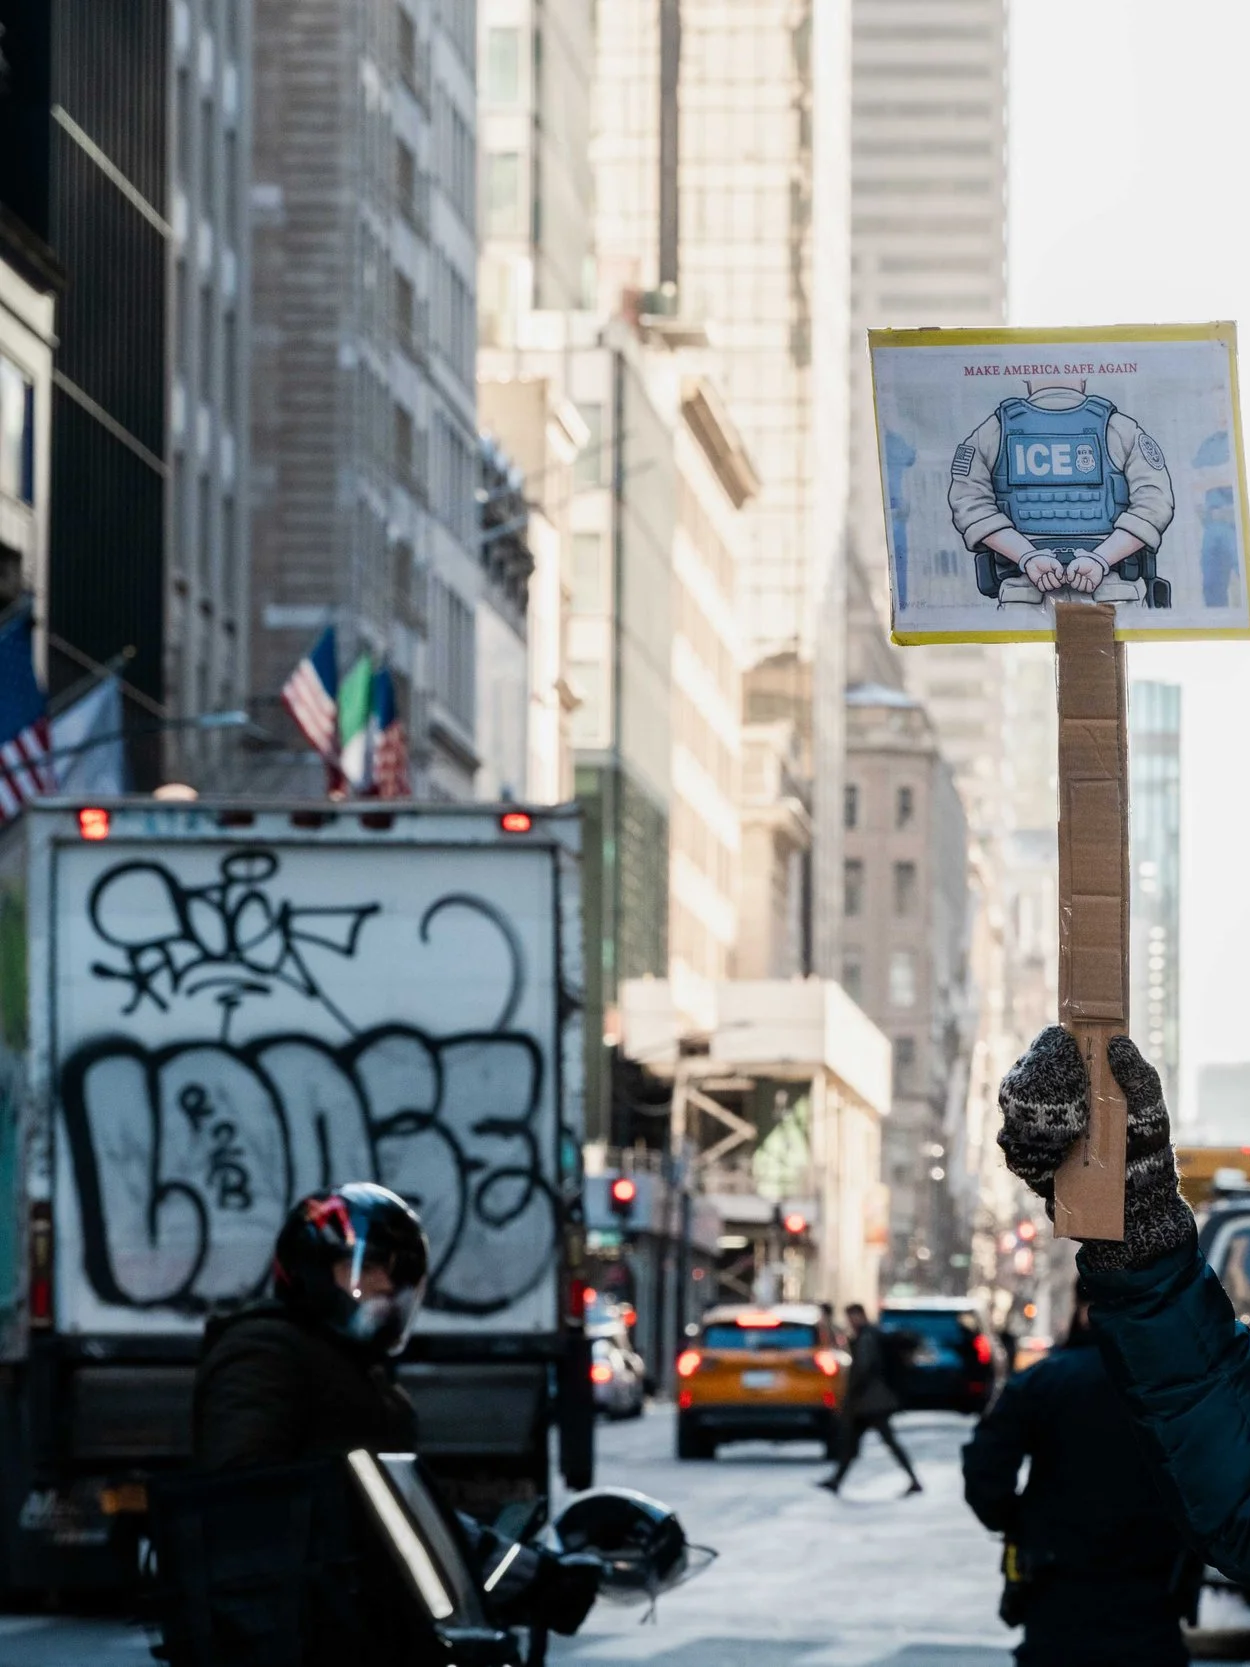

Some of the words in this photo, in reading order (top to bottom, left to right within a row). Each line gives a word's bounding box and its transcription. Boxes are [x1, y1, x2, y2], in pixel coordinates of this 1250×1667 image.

[964, 365, 1001, 377] MAKE
[1003, 364, 1060, 376] AMERICA
[1064, 363, 1095, 375] SAFE
[1098, 363, 1137, 374] AGAIN
[1015, 443, 1073, 476] ICE
